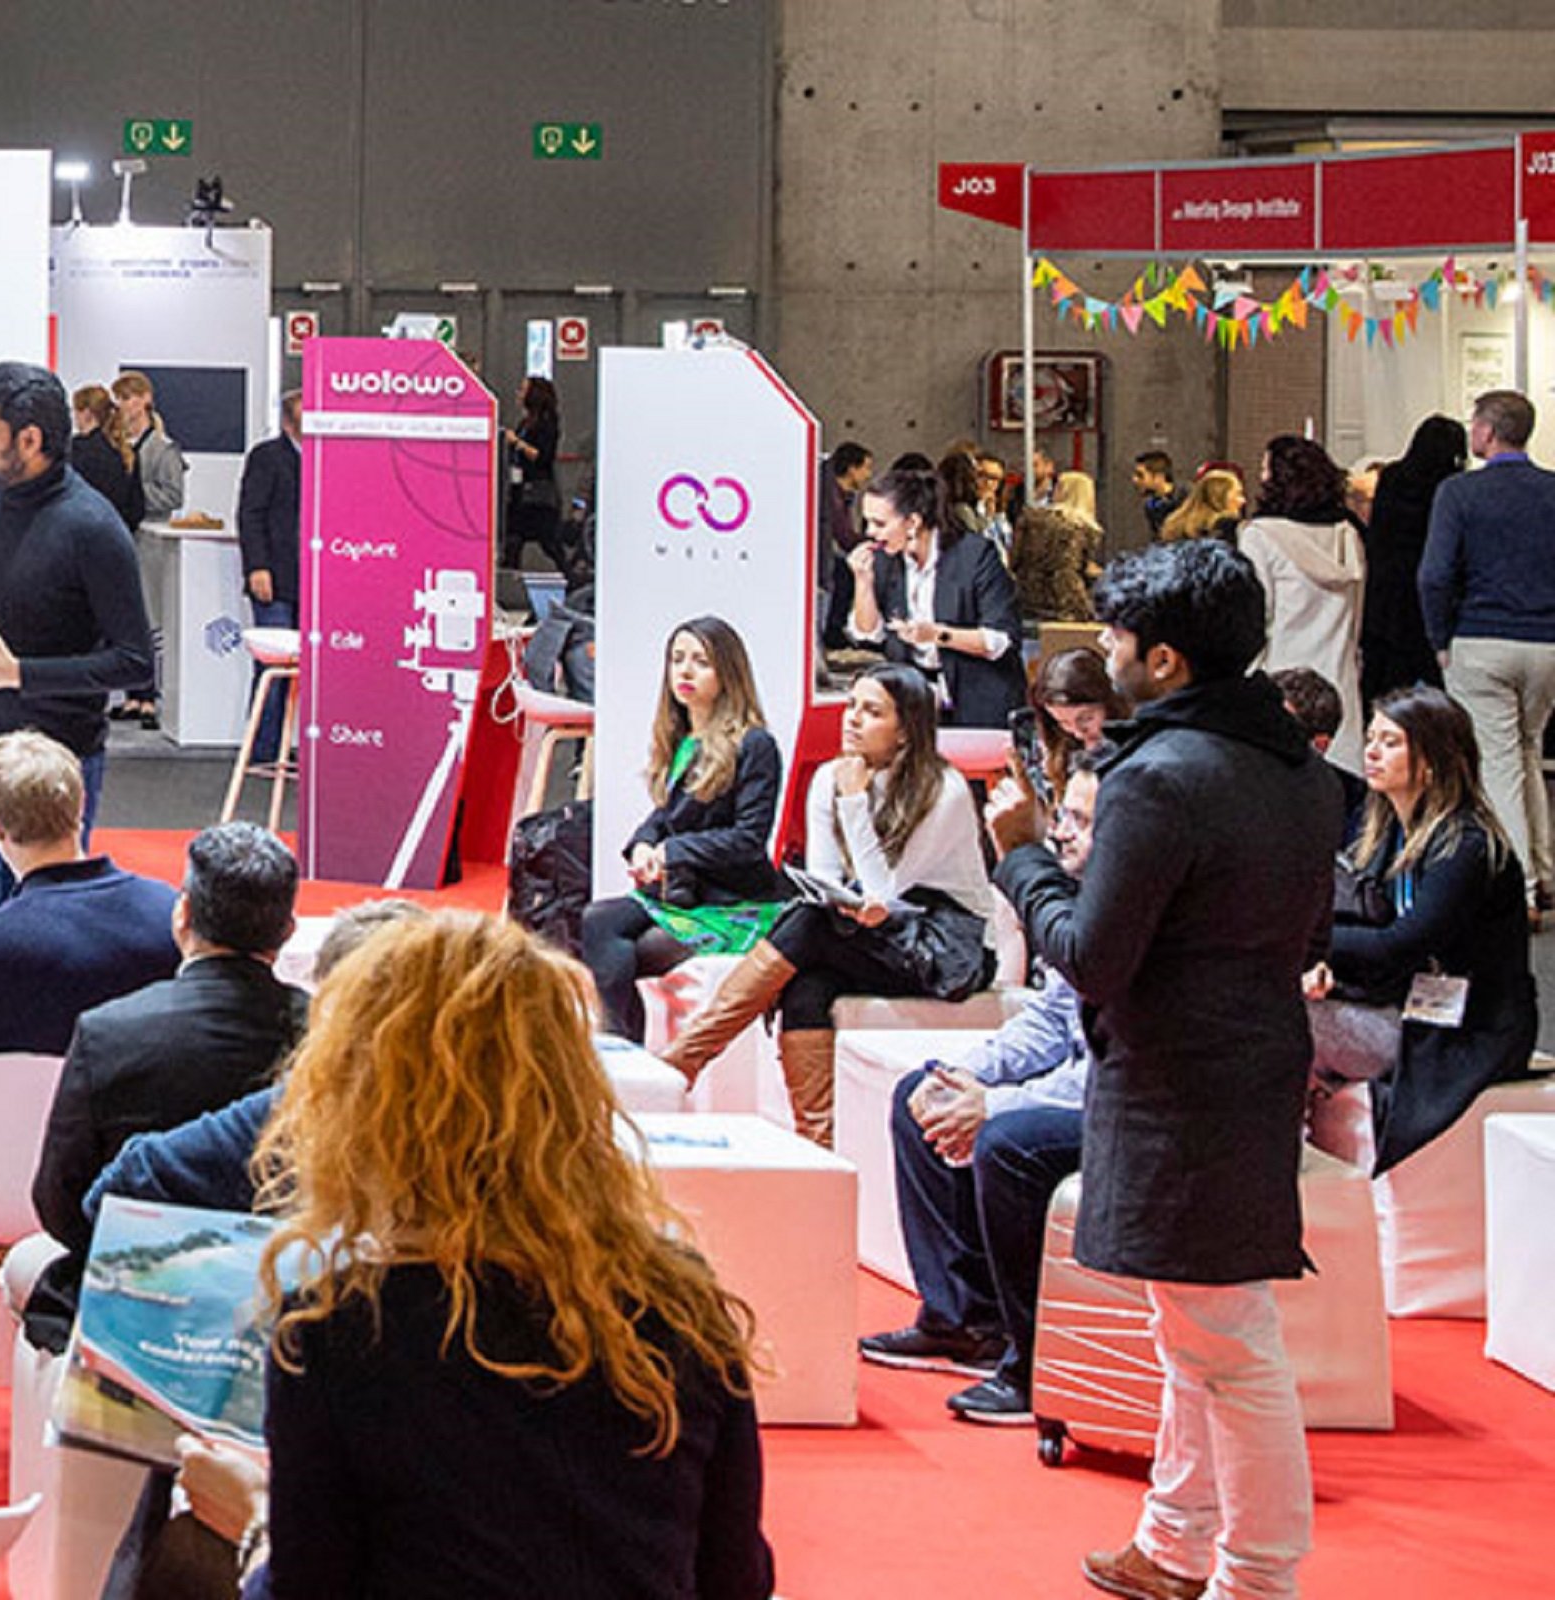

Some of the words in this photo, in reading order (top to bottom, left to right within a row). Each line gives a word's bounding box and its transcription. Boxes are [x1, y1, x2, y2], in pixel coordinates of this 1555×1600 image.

[952, 176, 996, 195] J03
[330, 369, 466, 398] wolowo
[330, 539, 398, 562] Capture
[329, 722, 384, 748] Share
[172, 1332, 223, 1351] Your
